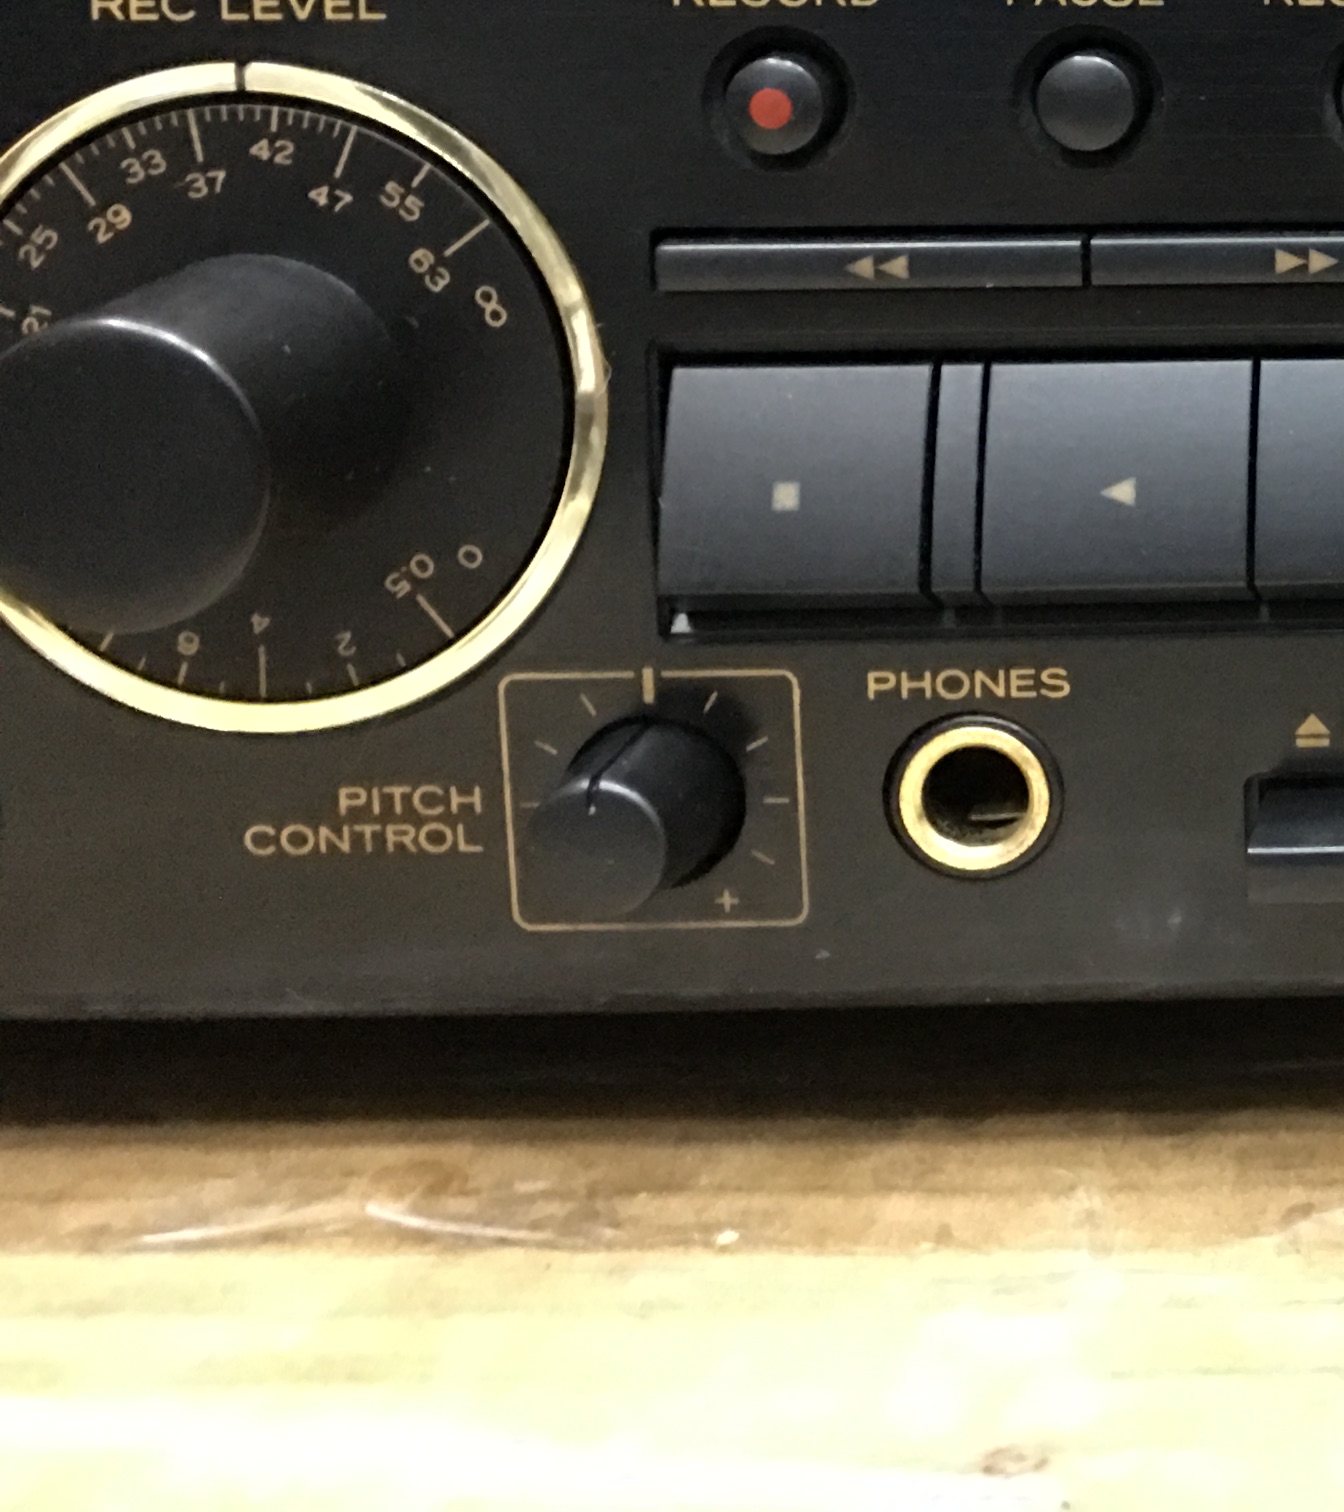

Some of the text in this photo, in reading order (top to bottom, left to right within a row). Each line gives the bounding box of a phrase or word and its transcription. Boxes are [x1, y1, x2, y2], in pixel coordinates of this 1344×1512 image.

[120, 150, 167, 184] 33
[249, 138, 295, 165] 42
[185, 169, 227, 199] 37
[308, 185, 353, 212] 47
[380, 184, 425, 222] 55
[88, 204, 132, 244] 29
[18, 229, 59, 269] 25
[408, 248, 451, 293] 63
[384, 553, 435, 598] 0.5
[250, 612, 271, 635] 4
[336, 630, 357, 657] 2
[867, 667, 1071, 700] PHONES
[338, 784, 482, 816] PITCH
[243, 821, 483, 856] CONTROL
